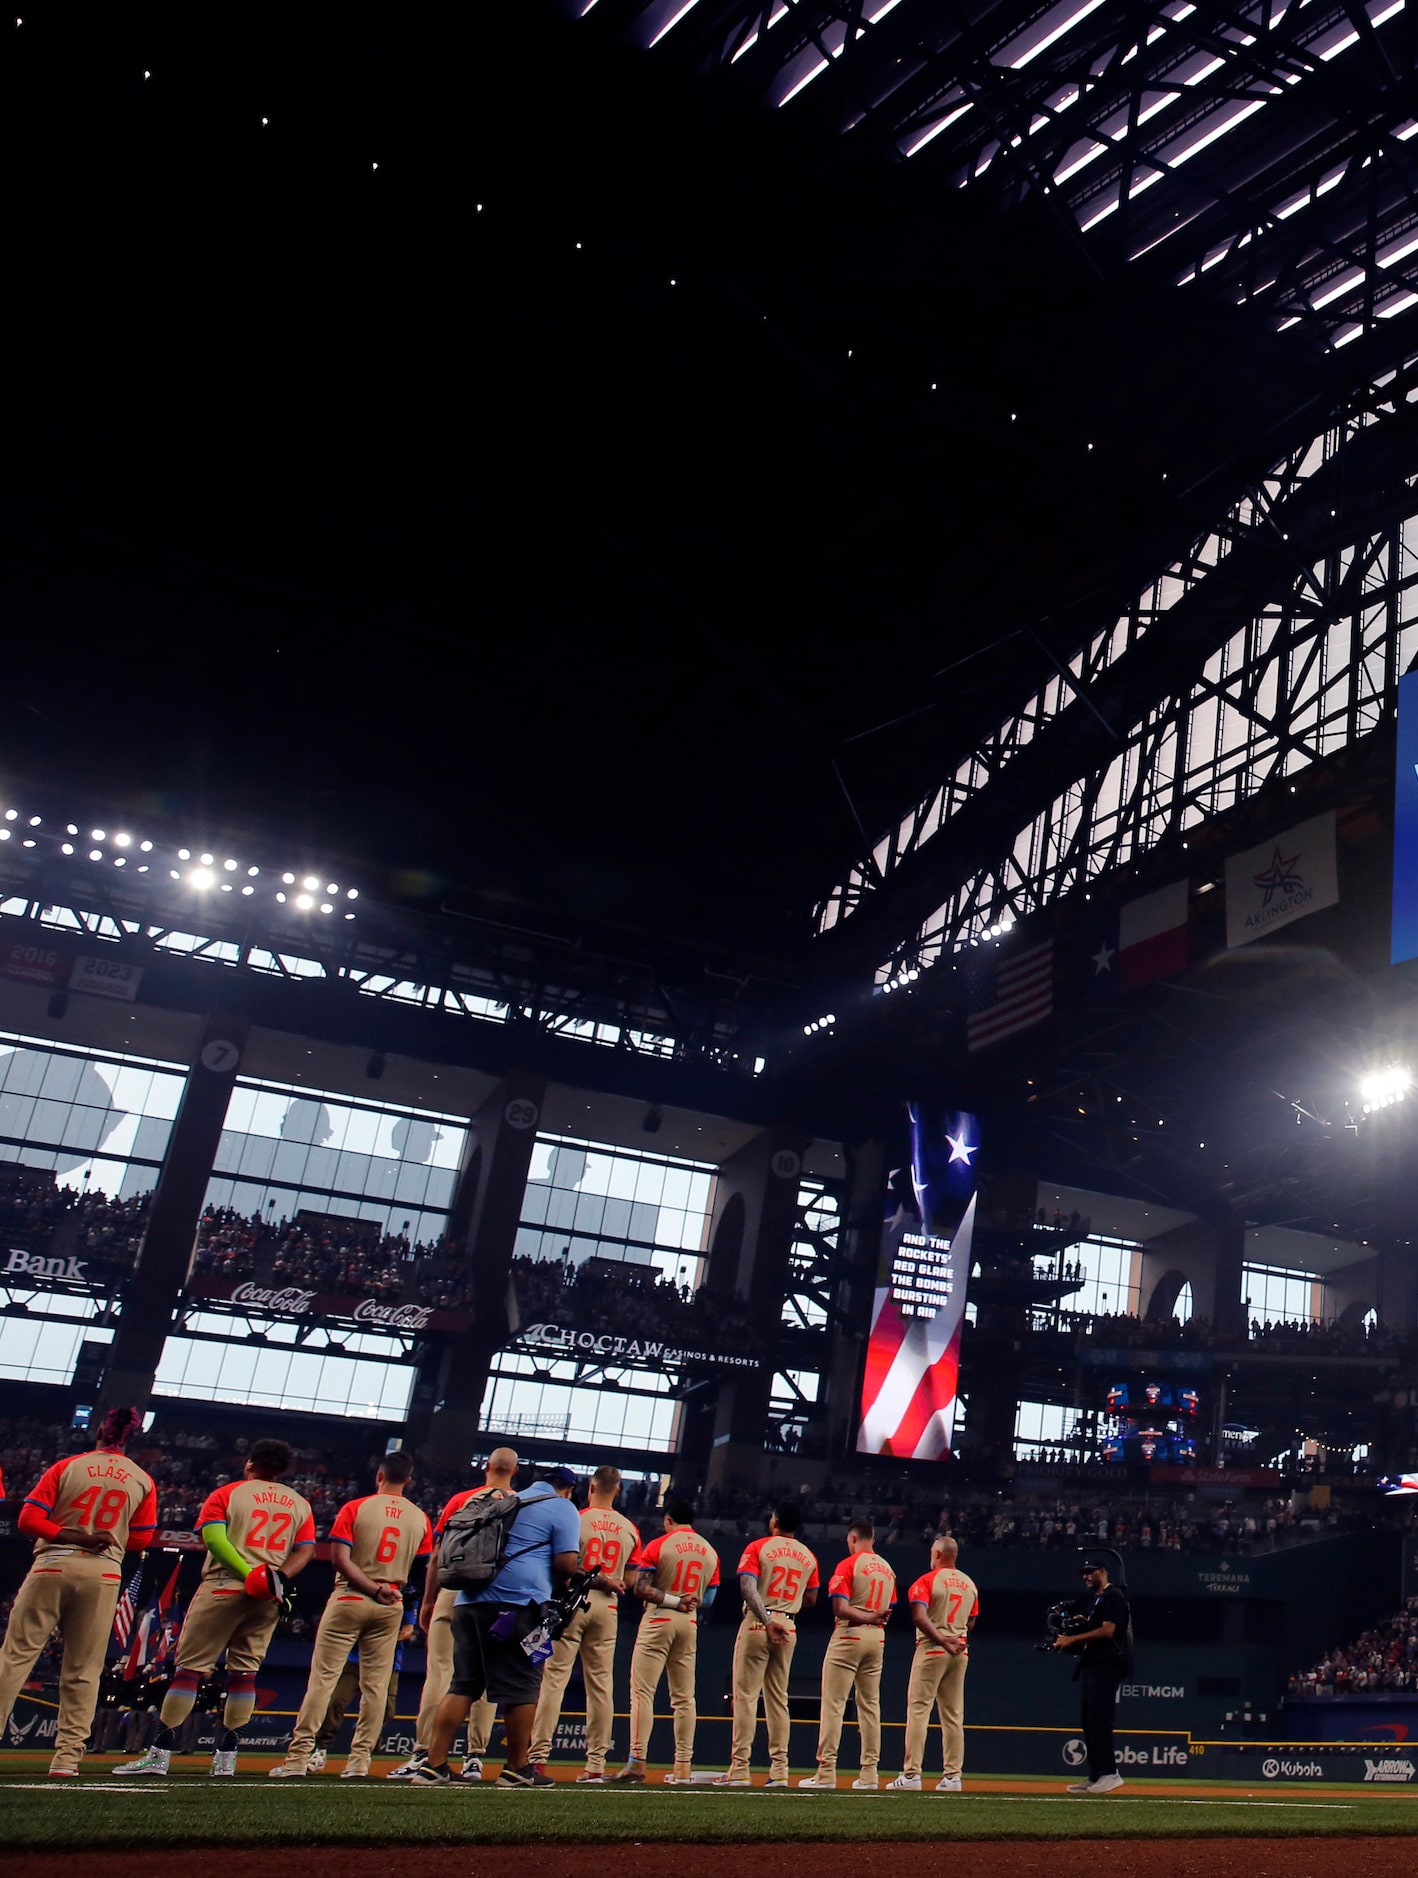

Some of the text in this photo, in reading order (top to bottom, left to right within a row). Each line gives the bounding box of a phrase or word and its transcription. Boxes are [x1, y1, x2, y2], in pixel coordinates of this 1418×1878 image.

[1246, 888, 1312, 928] ARLINGTON
[83, 959, 132, 981] 2023
[213, 1046, 230, 1065] 7
[509, 1103, 535, 1123] 29
[777, 1155, 795, 1173] 10
[903, 1233, 951, 1250] AND THE
[898, 1246, 952, 1264] ROCKETS'
[4, 1249, 90, 1281] Bank
[894, 1260, 954, 1279] RED GLARE
[891, 1274, 954, 1293] THE BOMBS
[893, 1288, 948, 1306] BURSTING
[902, 1304, 937, 1319] IN AIR
[540, 1323, 760, 1368] CHOCTAW CASINOS & RESORTS
[87, 1466, 132, 1484] CLASE
[1092, 1467, 1127, 1479] GOLD
[70, 1485, 127, 1530] 48
[253, 1493, 296, 1509] NAYLOR
[385, 1506, 403, 1519] FRY
[245, 1509, 292, 1552] 22
[591, 1517, 622, 1536] HOUCK
[375, 1526, 400, 1564] 6
[675, 1543, 708, 1557] DURAN
[582, 1537, 621, 1574] 89
[767, 1548, 812, 1569] SANTANDER
[671, 1560, 703, 1593] 16
[767, 1566, 803, 1601] 25
[1198, 1573, 1250, 1583] TEREMANA
[865, 1578, 884, 1610] 11
[946, 1594, 962, 1624] 7
[1121, 1685, 1184, 1698] BETMGM
[239, 1737, 278, 1746] MARTIN
[1189, 1745, 1205, 1755] 410
[1153, 1746, 1188, 1765] Life
[1281, 1760, 1323, 1777] Kubota
[1377, 1760, 1409, 1774] ARROW
